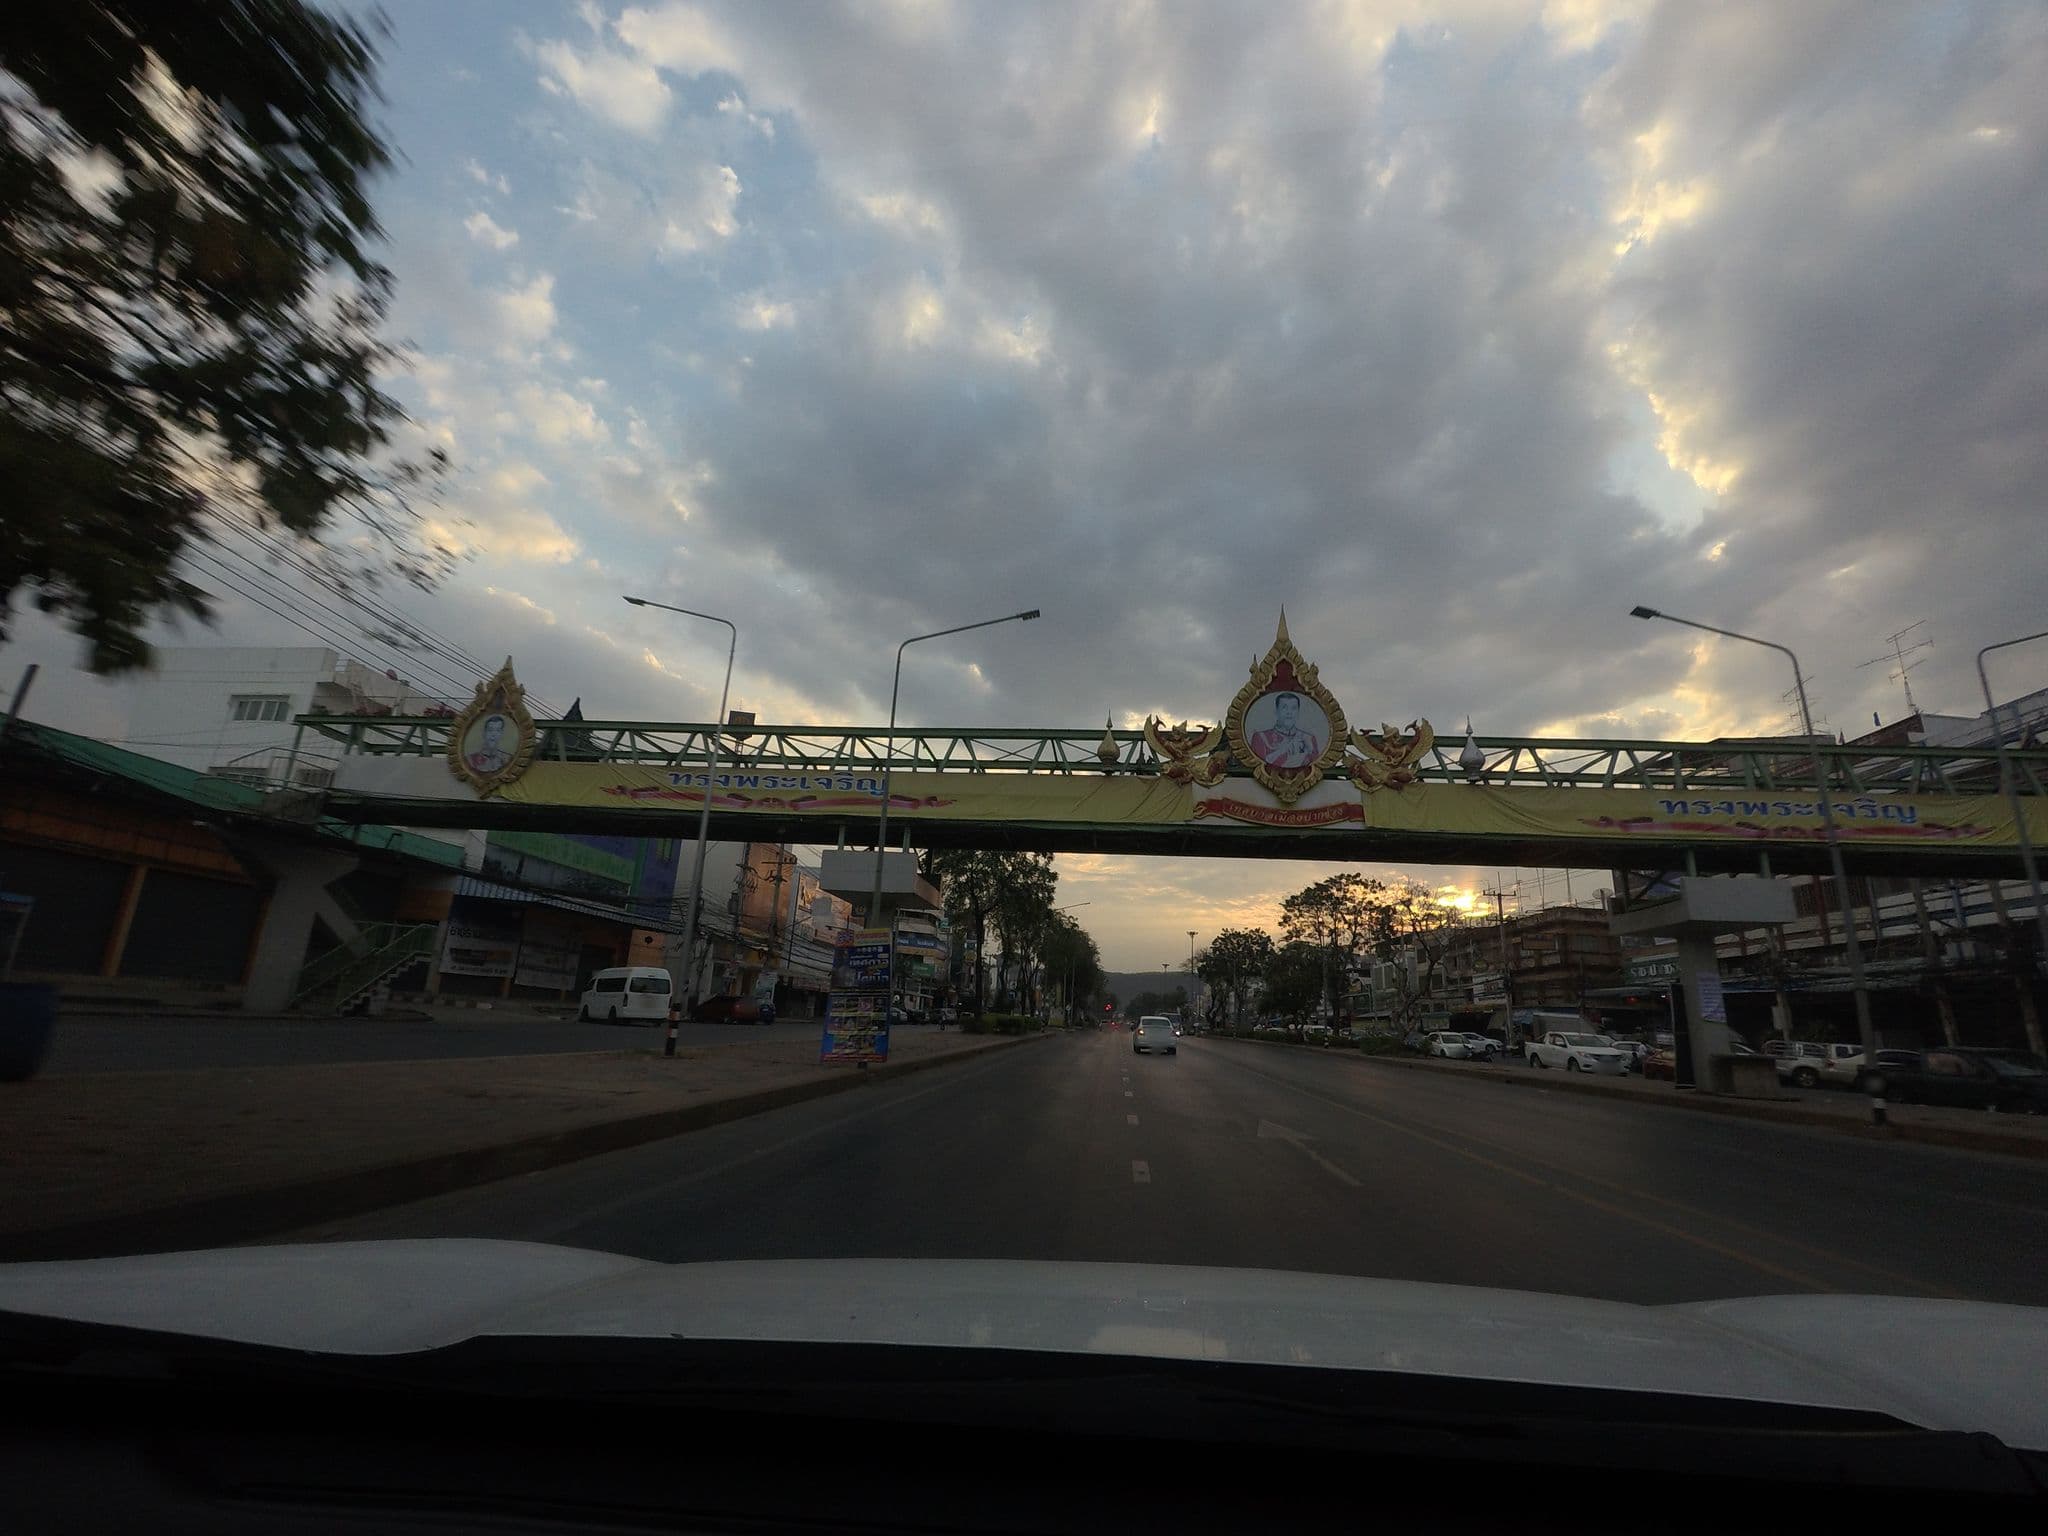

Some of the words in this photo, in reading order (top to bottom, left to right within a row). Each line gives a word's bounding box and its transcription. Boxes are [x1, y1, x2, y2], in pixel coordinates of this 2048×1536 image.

[668, 771, 888, 796] ทรงพระเจริญ
[1658, 797, 1918, 824] ทรงพระเจริญ
